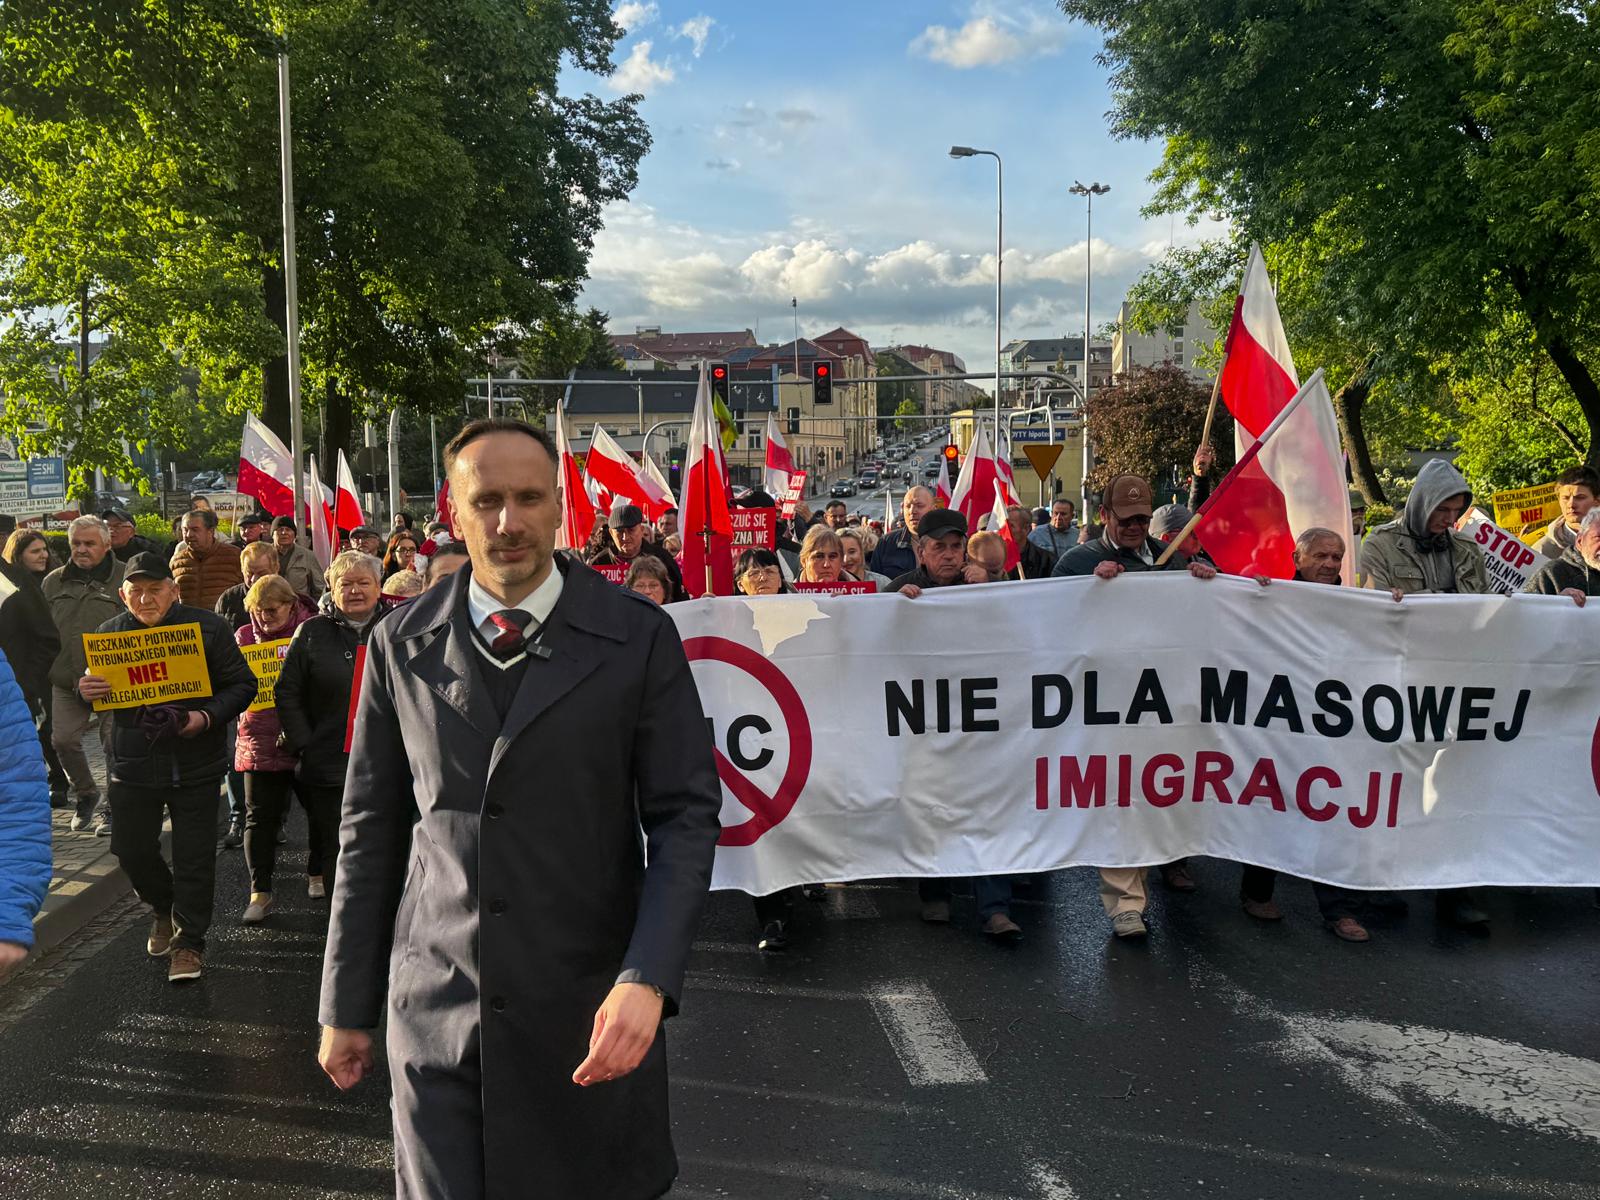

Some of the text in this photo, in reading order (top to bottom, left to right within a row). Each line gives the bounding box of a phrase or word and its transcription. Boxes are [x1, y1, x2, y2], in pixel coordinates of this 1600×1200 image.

[753, 513, 767, 529] SIĘ
[1520, 507, 1543, 523] NIE!
[755, 530, 768, 544] WE
[1474, 522, 1535, 569] STOP
[87, 628, 197, 653] MIESZKAŃCY PIOTRKOWA
[89, 642, 200, 667] TRYBUNALSKIEGO MÓWIĄ
[127, 661, 169, 686] NIE!
[100, 680, 203, 705] NIELEGALNEJ MIGRACJI!
[884, 666, 1531, 744] NIE DLA MASOWEJ
[1035, 750, 1403, 829] IMIGRACJI
